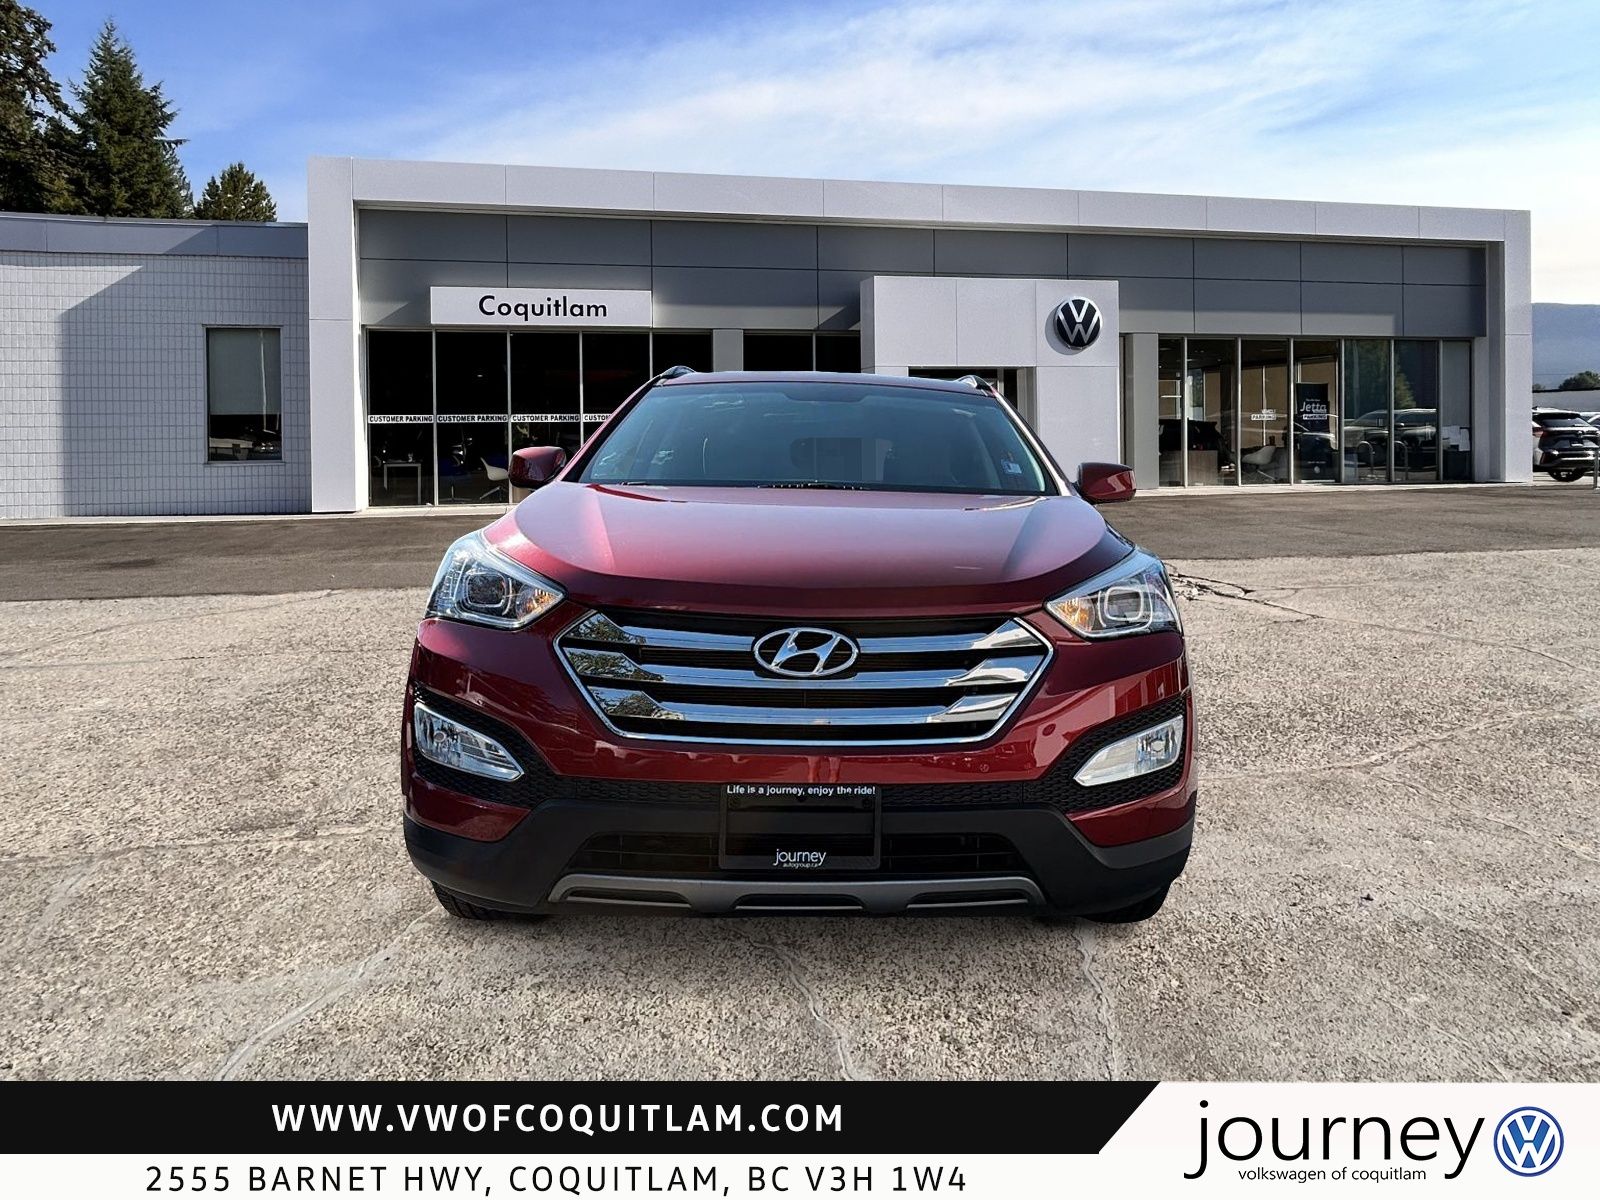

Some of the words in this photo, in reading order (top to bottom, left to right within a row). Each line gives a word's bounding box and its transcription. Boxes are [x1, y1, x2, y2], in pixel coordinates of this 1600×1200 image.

[478, 294, 607, 322] Coquitlam
[727, 785, 746, 794] Life
[747, 785, 756, 794] is
[766, 785, 805, 796] journey,
[807, 785, 834, 796] enjoy
[837, 785, 852, 794] the
[854, 785, 876, 795] ride!
[773, 848, 826, 866] journey
